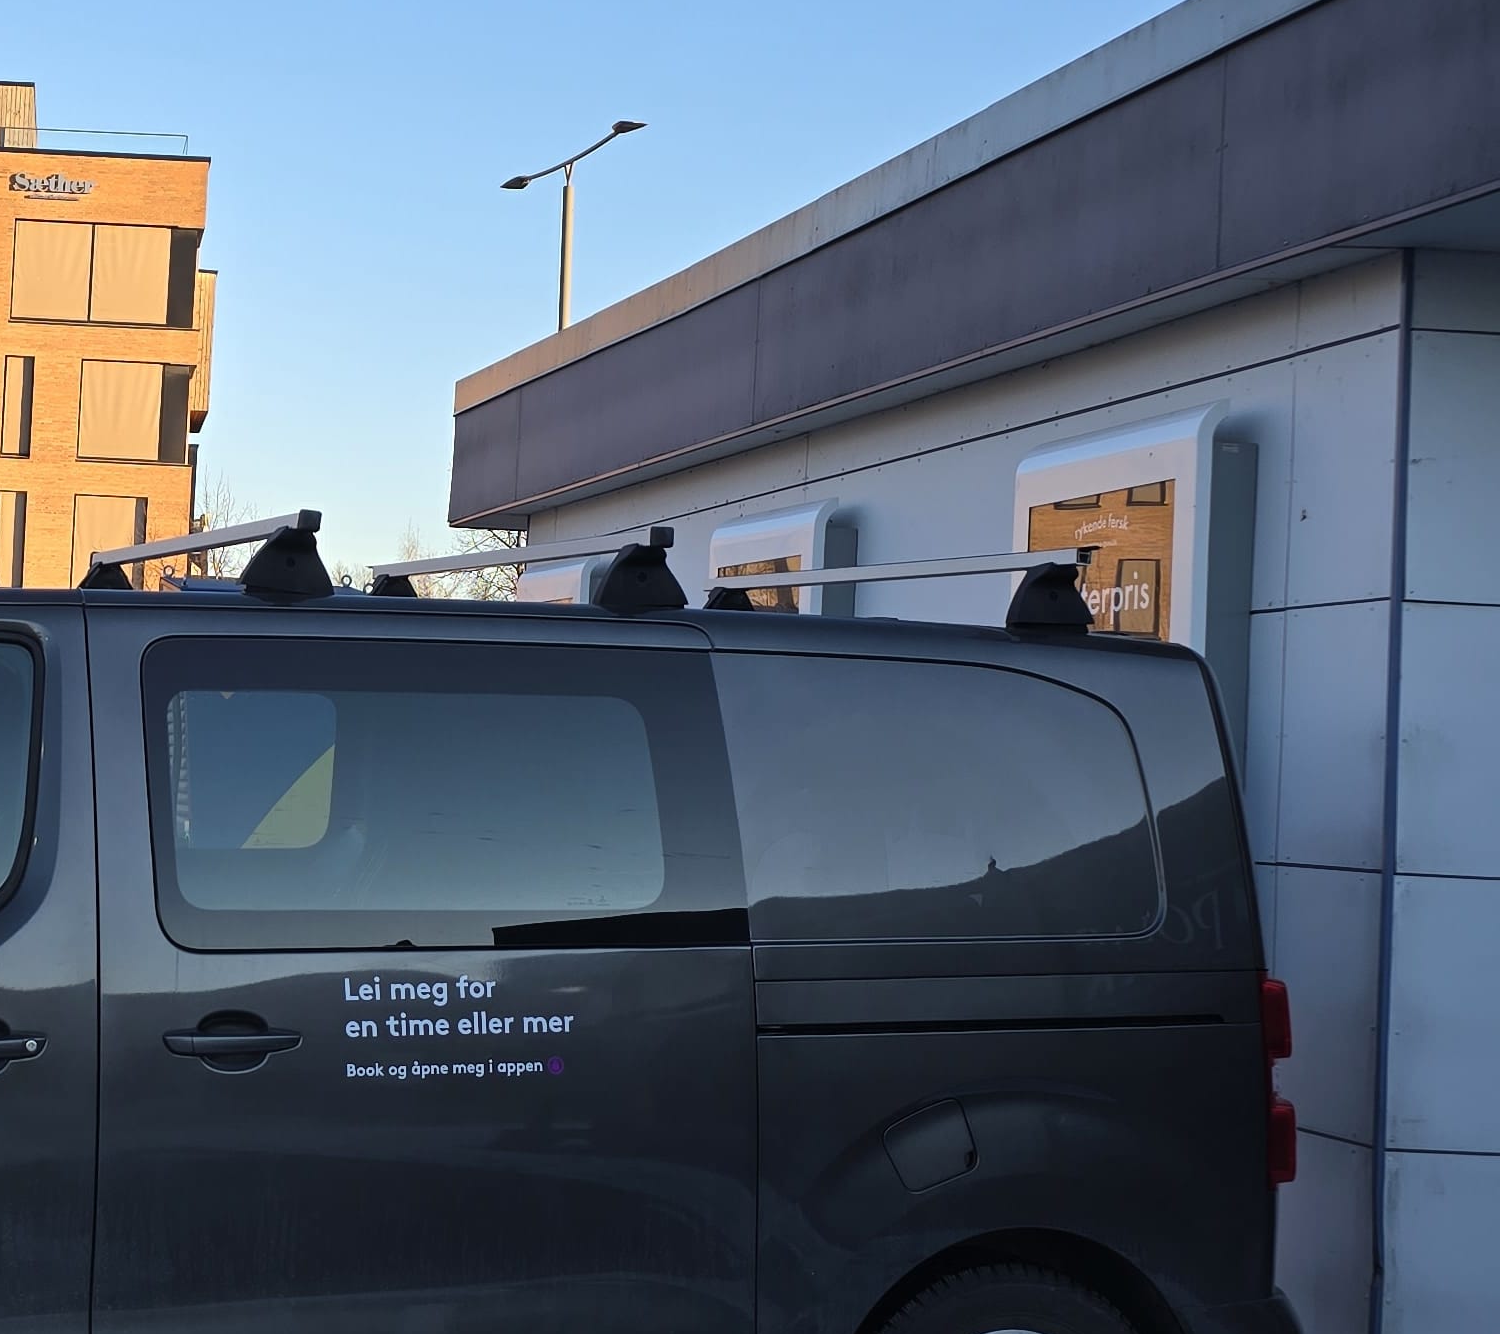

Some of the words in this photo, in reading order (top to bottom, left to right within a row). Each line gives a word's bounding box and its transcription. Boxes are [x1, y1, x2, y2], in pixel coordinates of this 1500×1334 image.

[9, 171, 93, 194] Sæther
[1081, 571, 1150, 625] terpris
[344, 976, 381, 1001] Lei
[390, 981, 448, 1006] meg
[456, 975, 496, 999] for
[345, 1019, 378, 1038] en
[386, 1012, 450, 1037] time
[457, 1011, 514, 1035] eller
[523, 1015, 574, 1034] mer
[346, 1063, 385, 1077] Book
[388, 1065, 407, 1079] og
[411, 1060, 449, 1079] åpne
[452, 1062, 485, 1078] meg
[488, 1059, 493, 1073] i
[497, 1061, 543, 1077] appen
